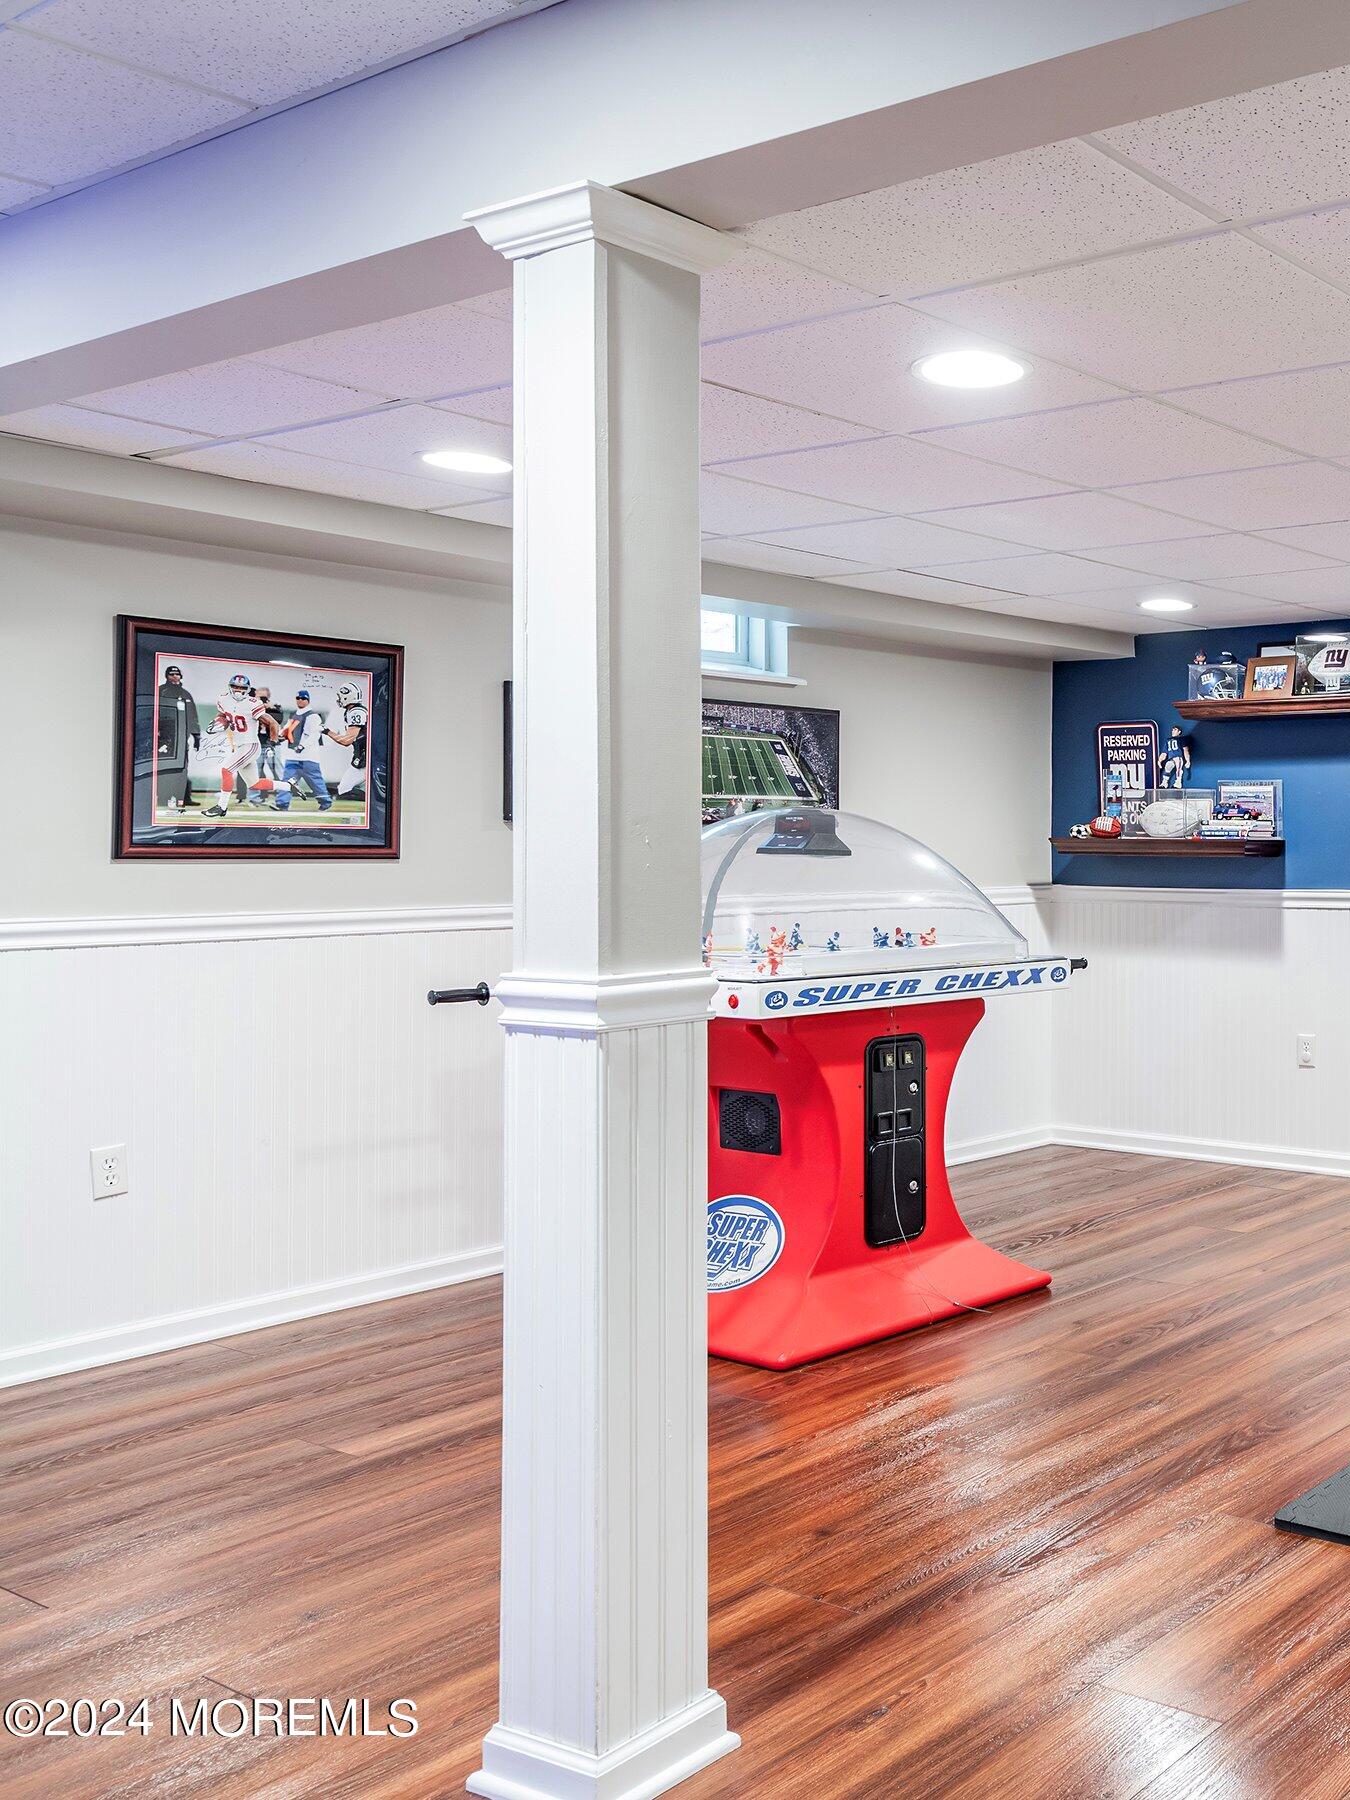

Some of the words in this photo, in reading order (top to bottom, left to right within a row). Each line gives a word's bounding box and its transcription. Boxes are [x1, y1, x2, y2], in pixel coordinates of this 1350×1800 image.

[1324, 649, 1349, 668] ny
[350, 714, 362, 726] 33
[1103, 735, 1151, 747] RESERVED
[1167, 740, 1179, 751] 10
[1107, 749, 1147, 761] PARKING
[792, 978, 921, 1008] SUPER
[933, 966, 1048, 993] CHEXX
[707, 1213, 769, 1242] SUPER
